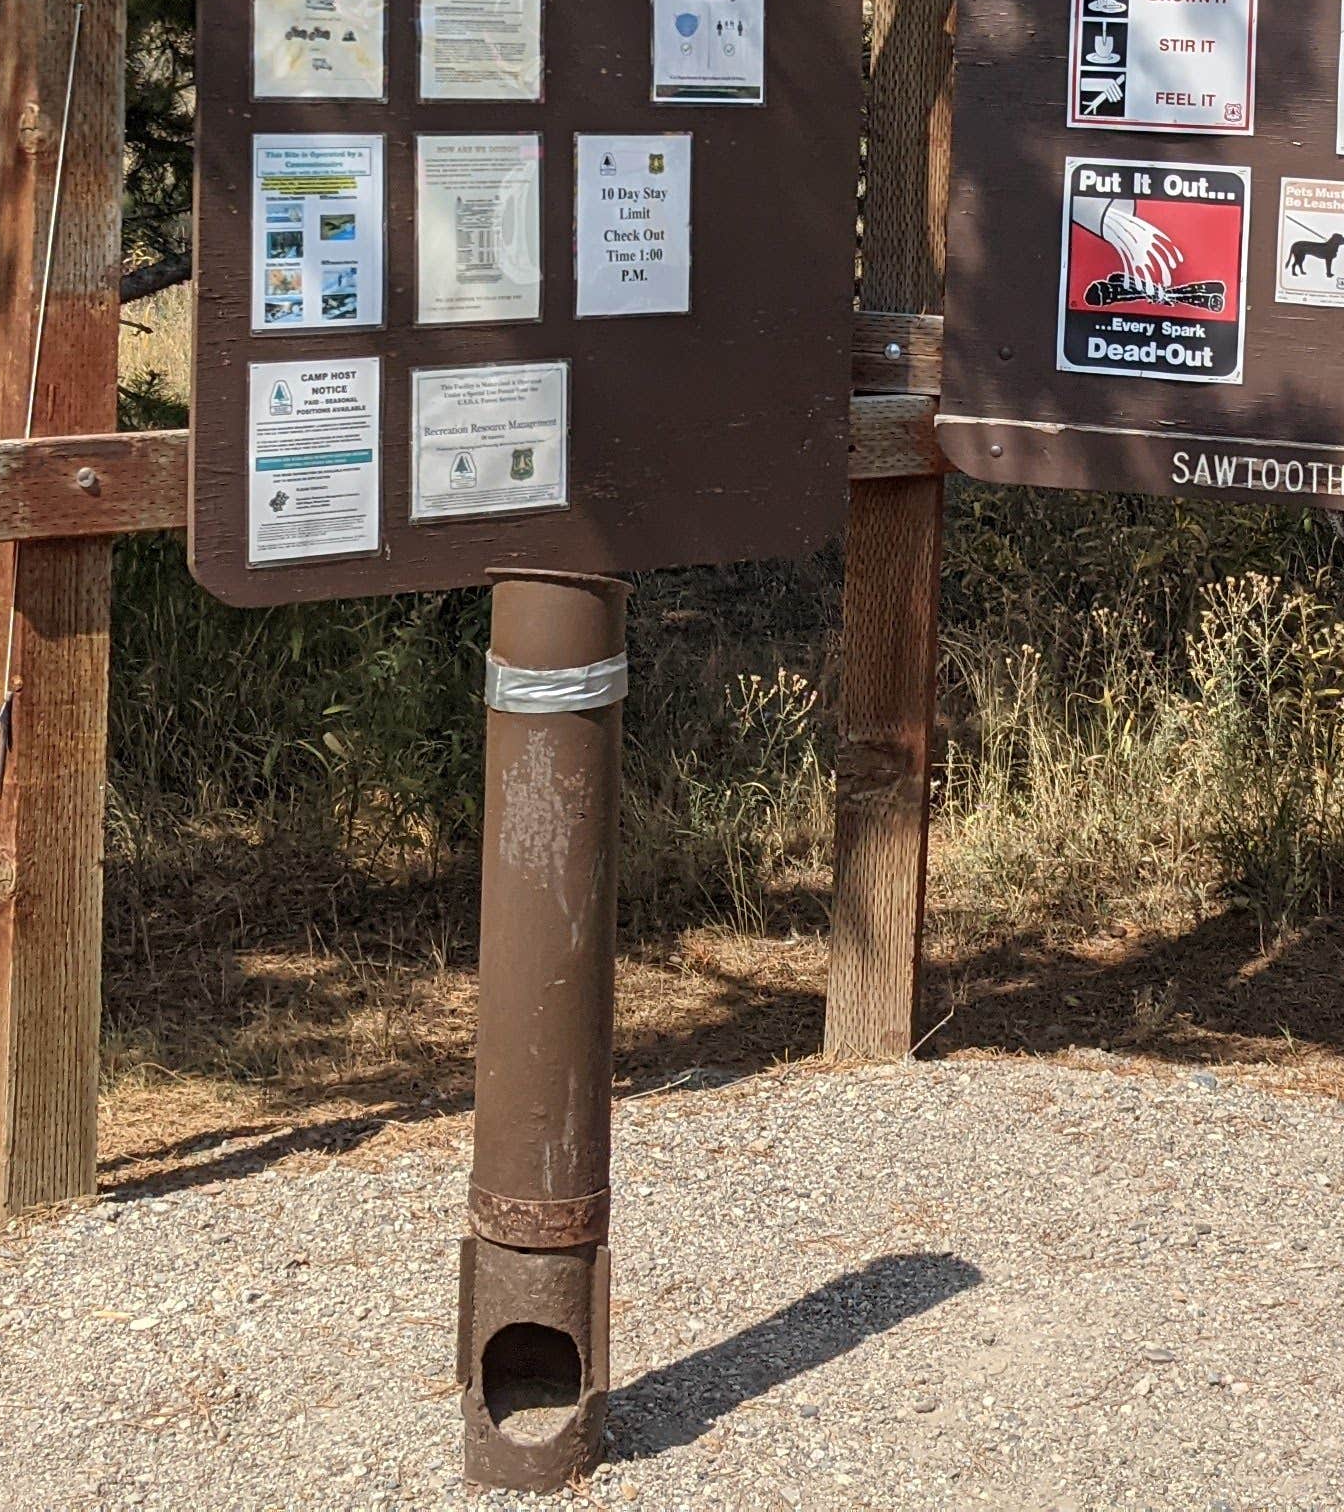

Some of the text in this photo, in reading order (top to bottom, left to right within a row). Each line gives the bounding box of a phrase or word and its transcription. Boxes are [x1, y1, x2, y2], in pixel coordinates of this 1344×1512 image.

[1159, 39, 1215, 53] STIR IT
[1155, 92, 1216, 107] FEEL IT
[1080, 170, 1235, 201] Put It Out...
[602, 188, 668, 202] 10 Day Stay
[1286, 186, 1344, 199] Pets Must
[1285, 197, 1302, 207] Be
[620, 207, 650, 220] Limit
[604, 229, 664, 242] Check Out
[607, 248, 662, 262] Time 1:00
[621, 269, 648, 281] P.M.
[1095, 318, 1206, 338] ...Every Spark
[1088, 337, 1213, 368] Dead-Out
[301, 371, 356, 382] CAMP HOST
[312, 385, 347, 395] NOTICE
[296, 405, 366, 415] POSITIONS AVAILABLE
[424, 418, 556, 437] Recreation Resource Management
